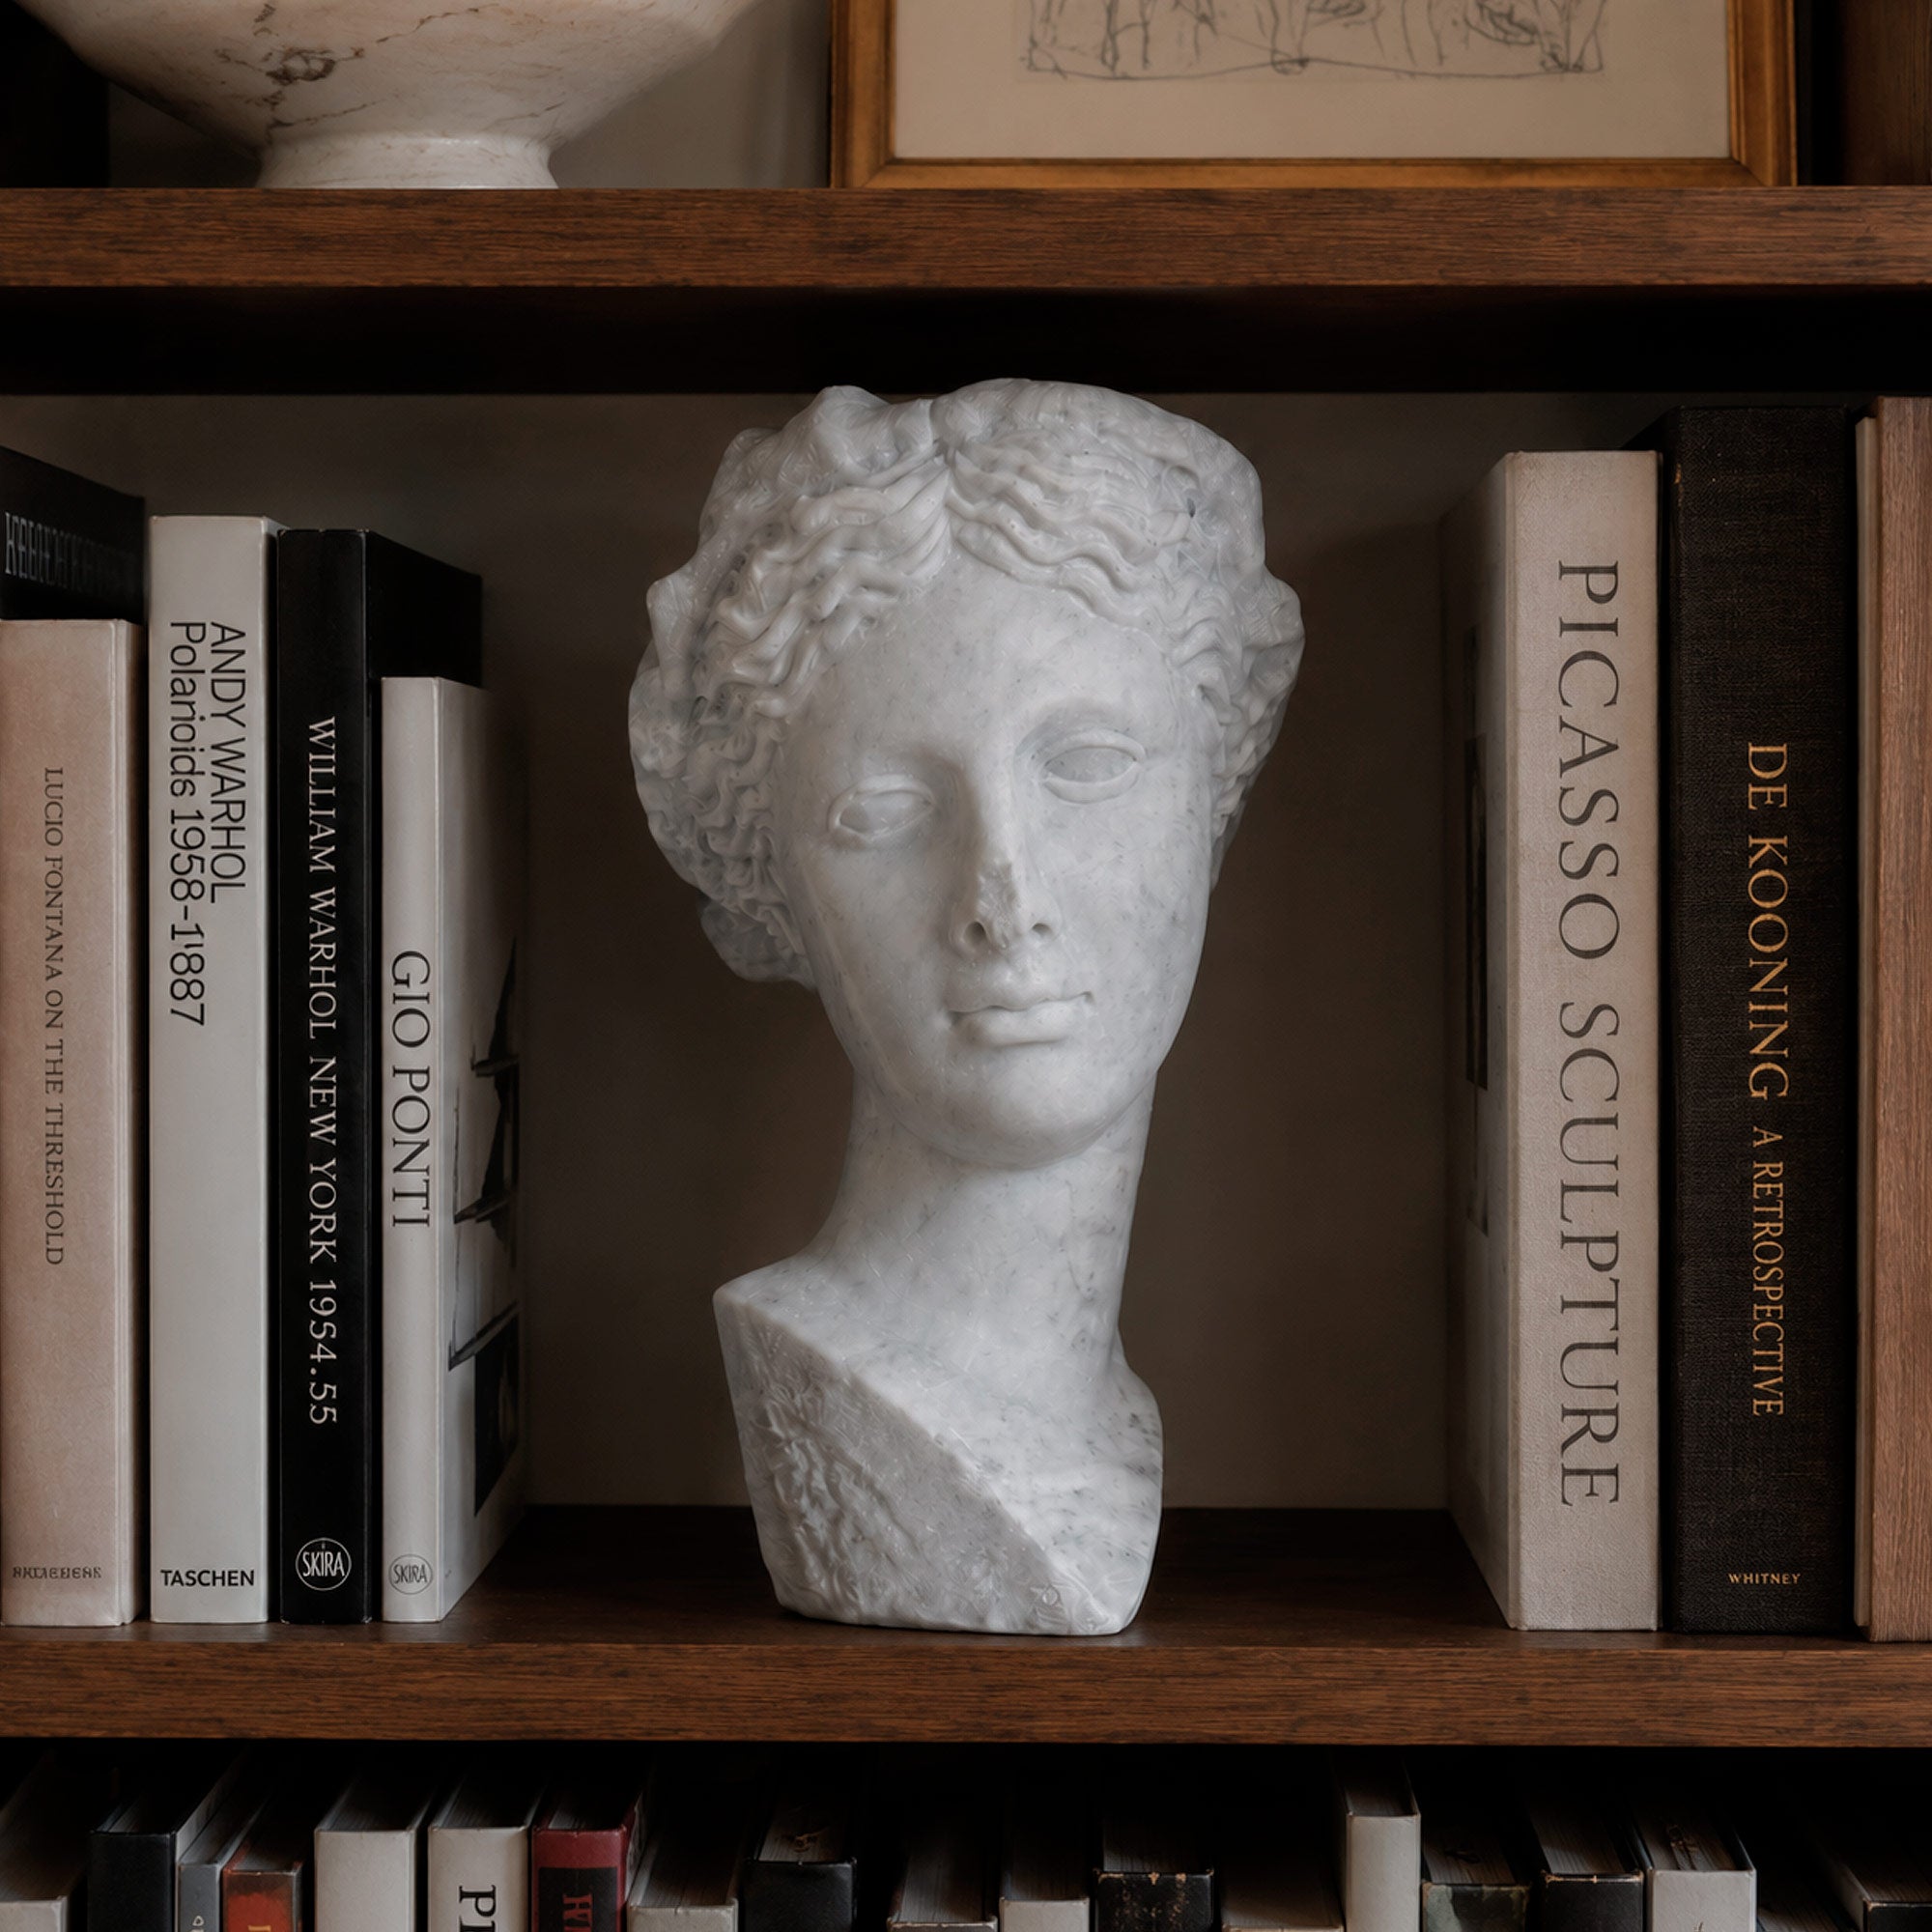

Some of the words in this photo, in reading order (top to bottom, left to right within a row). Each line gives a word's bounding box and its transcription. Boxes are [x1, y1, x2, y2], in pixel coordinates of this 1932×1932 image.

[210, 621, 246, 728] ANDY
[44, 768, 64, 847] LUCIO
[308, 716, 336, 872] WILLIAM
[1558, 560, 1621, 960] PICASSO
[1747, 742, 1788, 810] DE
[210, 737, 246, 904] WARHOL
[44, 856, 64, 981] FONTANA
[308, 886, 337, 1039] WARHOL
[1747, 835, 1789, 1100] KOONING
[44, 989, 64, 1029] ON
[391, 951, 431, 1048] GIO
[44, 1038, 64, 1094] THE
[309, 1056, 337, 1146] NEW
[44, 1102, 65, 1265] THRESHOLD
[391, 1065, 431, 1228] PONTI
[1752, 1125, 1783, 1148] A
[308, 1157, 337, 1264] YORK
[1559, 1002, 1621, 1507] SCULPTURE
[1752, 1160, 1784, 1416] RETROSPECTIVE
[309, 1279, 337, 1425] 1954.55
[160, 1569, 255, 1587] TASCHEN
[301, 1550, 345, 1577] SKIRA
[393, 1563, 428, 1585] SKIRA
[1727, 1572, 1802, 1585] WHITNEY
